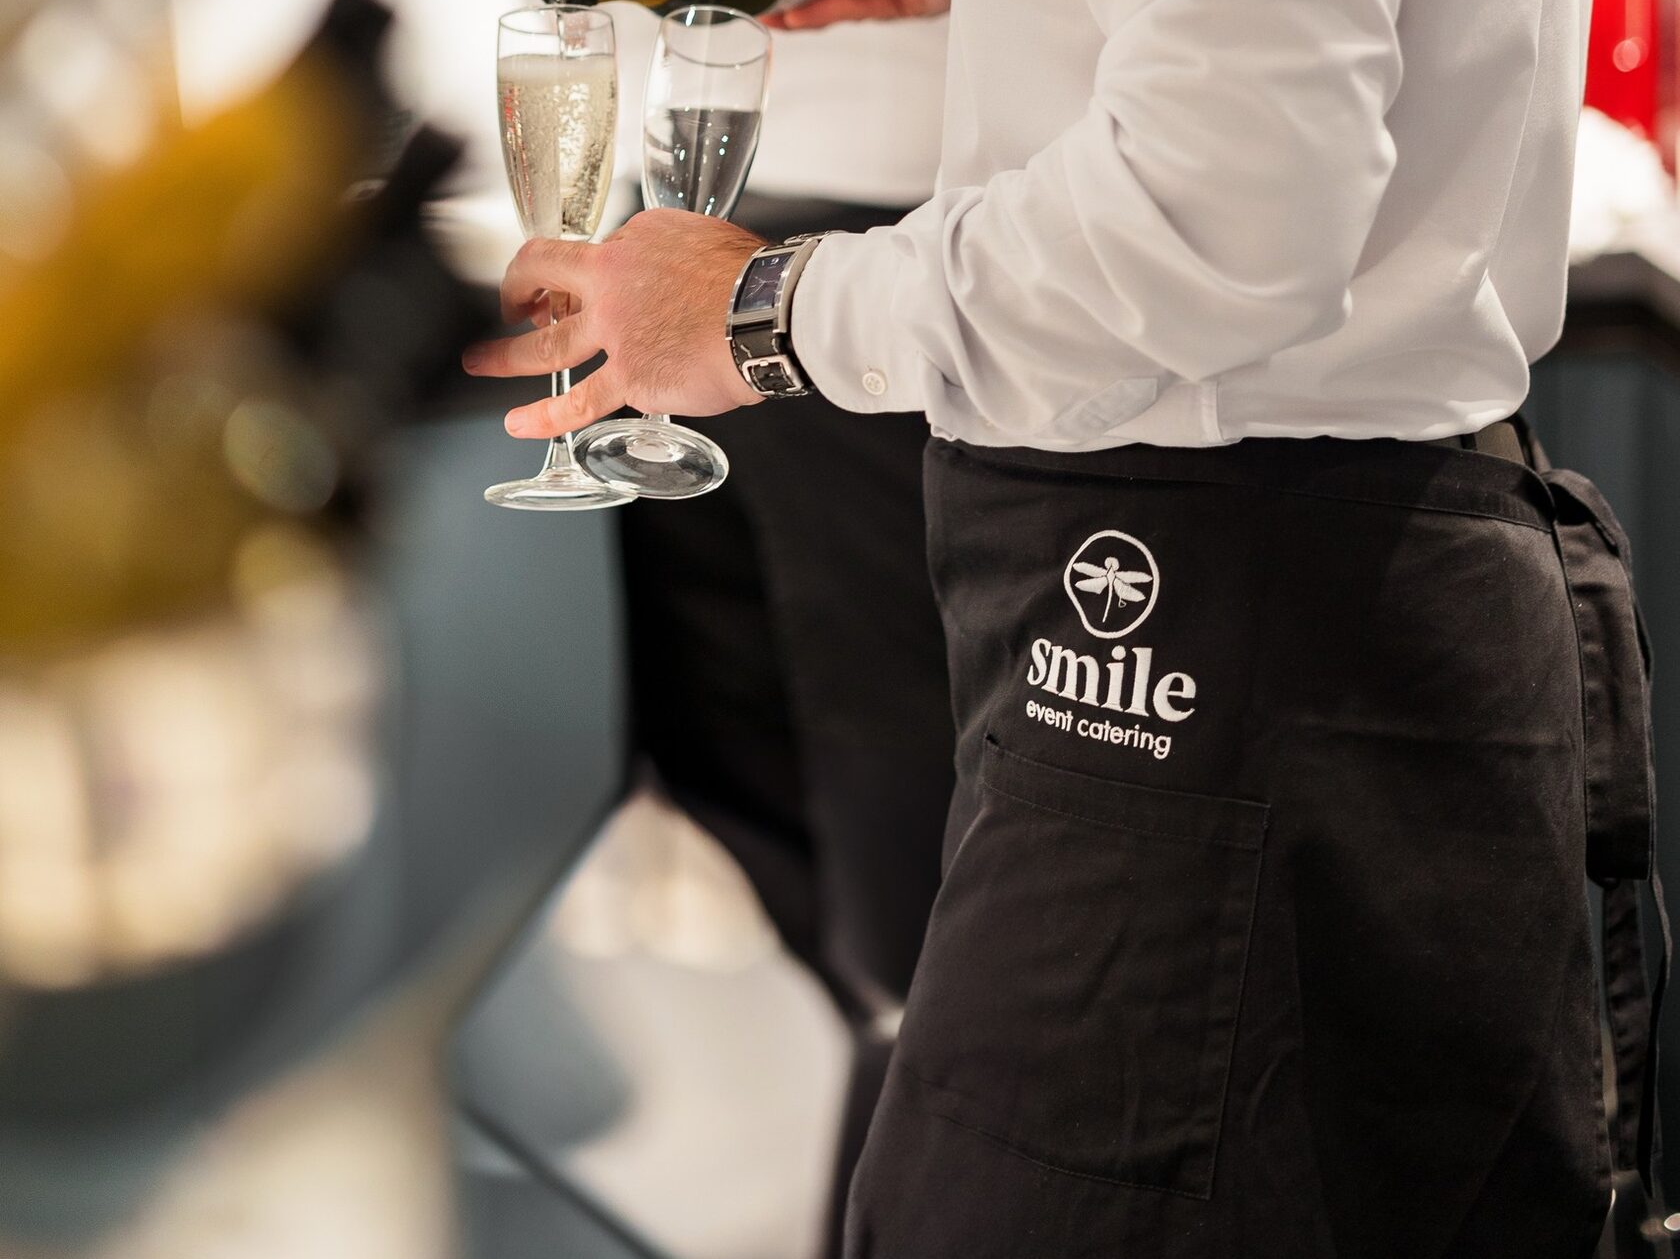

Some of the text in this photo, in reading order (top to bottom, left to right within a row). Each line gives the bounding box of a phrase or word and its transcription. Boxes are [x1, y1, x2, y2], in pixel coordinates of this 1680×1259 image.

[1027, 638, 1197, 722] smile
[1026, 700, 1172, 760] event catering
